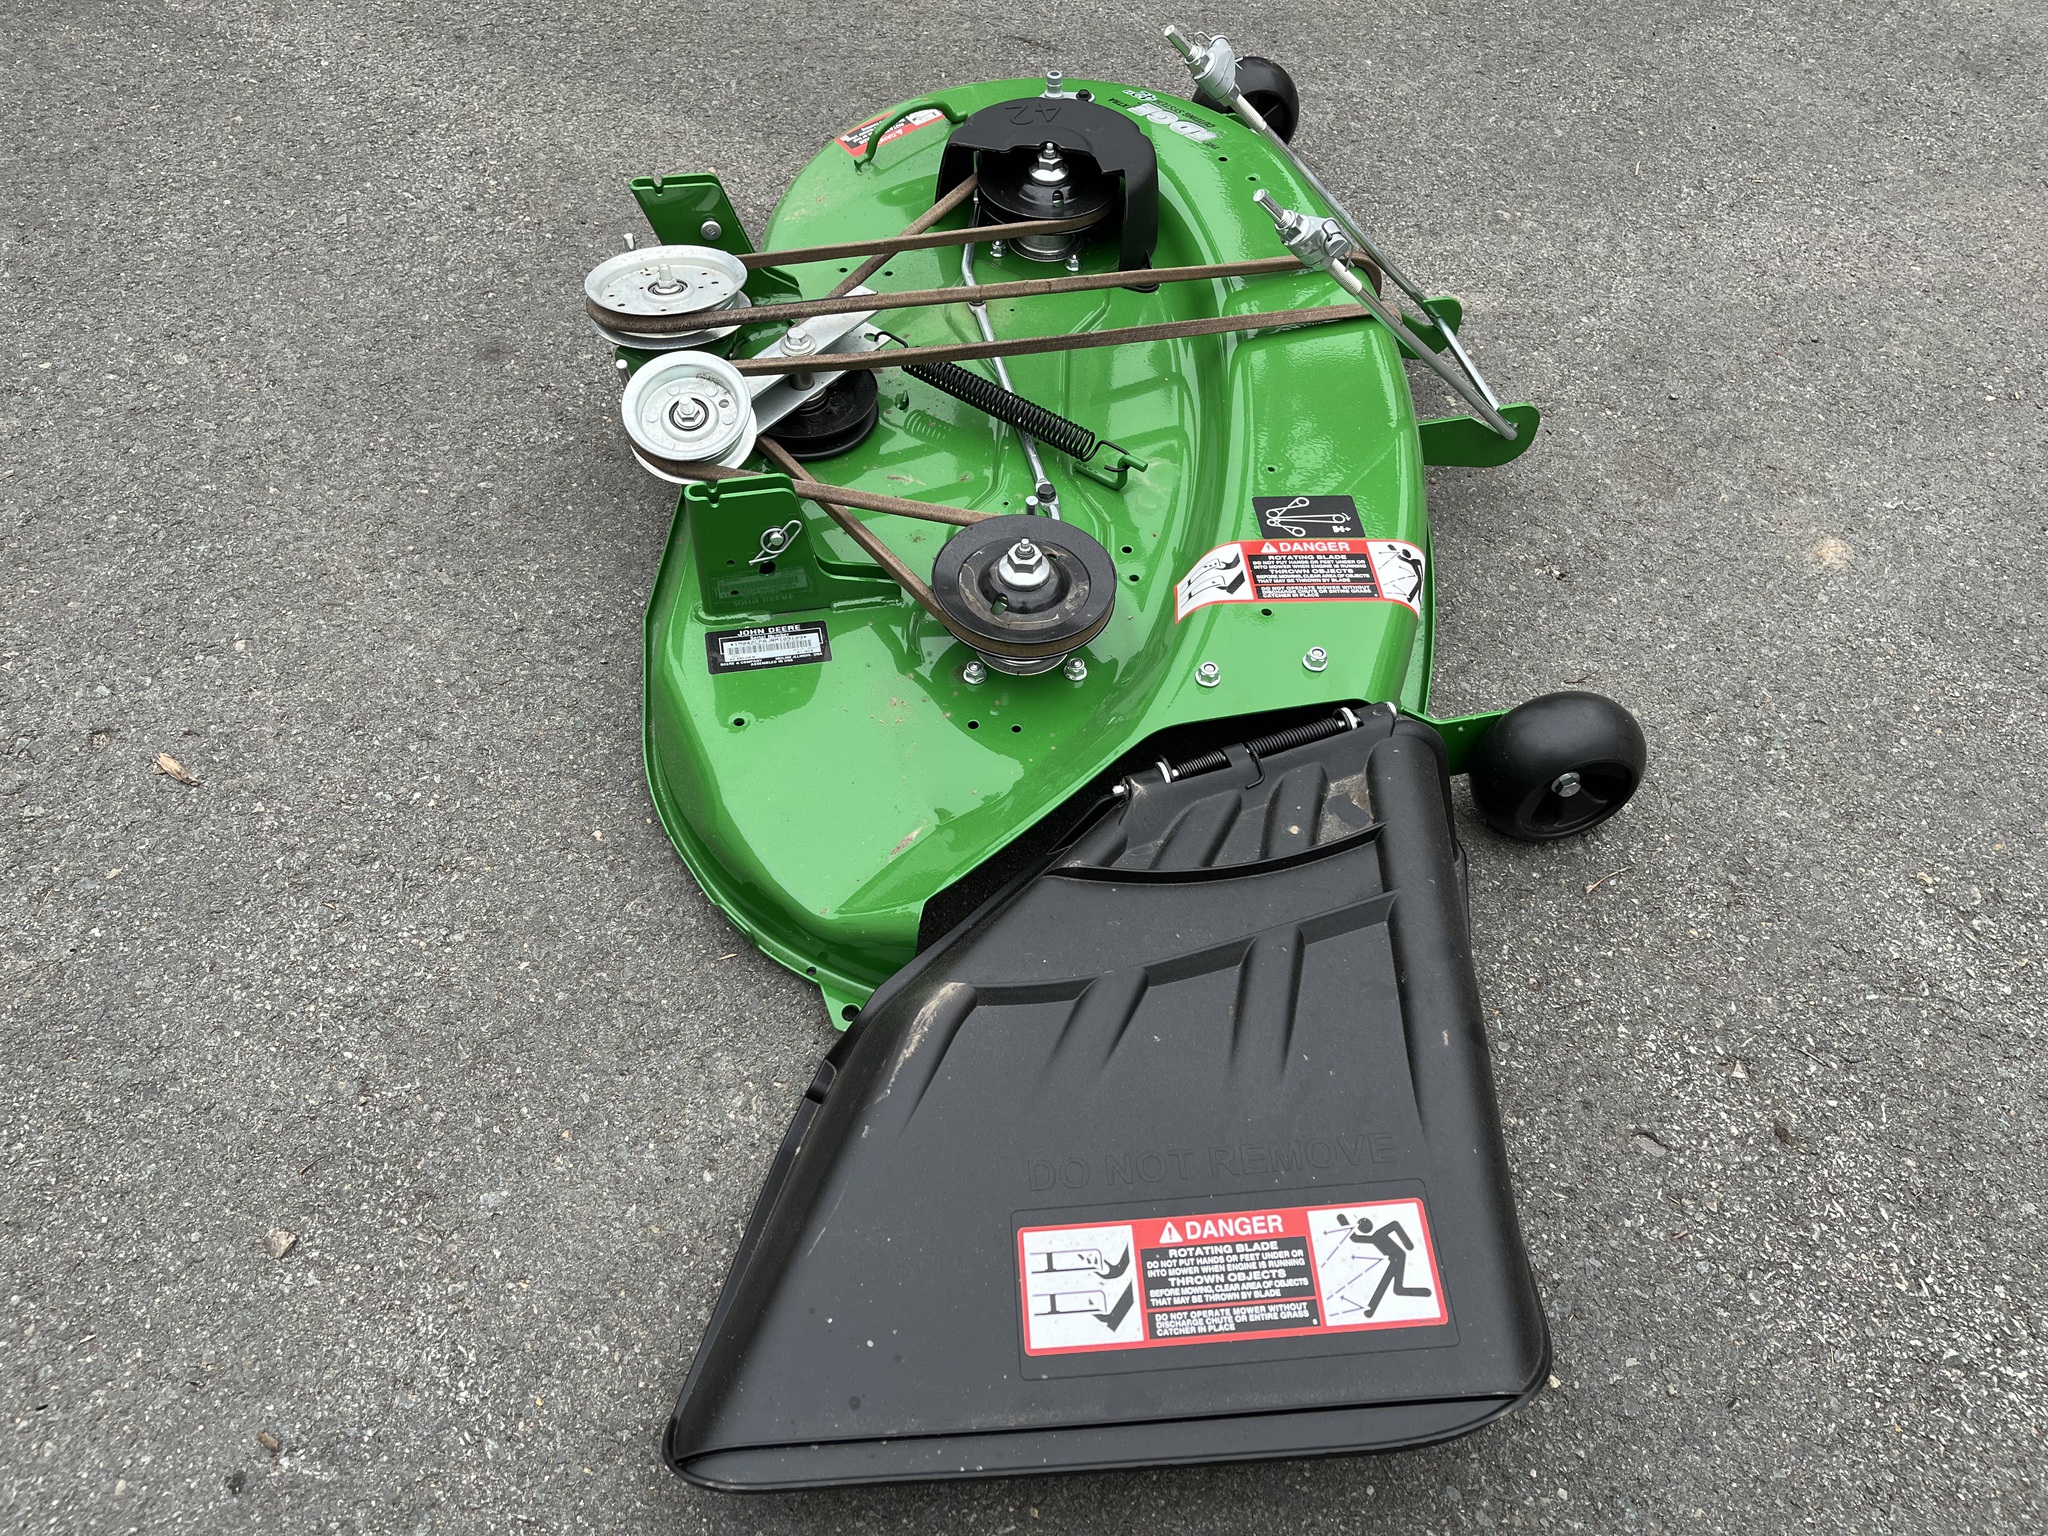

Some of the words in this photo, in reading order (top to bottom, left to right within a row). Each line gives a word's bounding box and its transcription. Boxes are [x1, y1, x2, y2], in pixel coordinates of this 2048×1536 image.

[1005, 102, 1062, 126] 42
[1152, 99, 1184, 114] SYSTEM
[1126, 102, 1218, 143] EDGE
[1182, 111, 1216, 128] CUTTING
[1279, 542, 1350, 552] DANGER
[737, 628, 765, 637] JOHN
[768, 624, 801, 634] DEERE
[1028, 1157, 1090, 1192] DO
[1105, 1148, 1194, 1186] NOT
[1208, 1131, 1398, 1178] REMOVE
[1185, 1214, 1284, 1240] DANGER
[1147, 1260, 1159, 1269] DO
[1160, 1259, 1177, 1268] NOT
[1178, 1258, 1195, 1267] PUT
[1197, 1256, 1224, 1265] HANDS
[1225, 1255, 1238, 1263] OR
[1240, 1253, 1260, 1262] FEET
[1262, 1251, 1289, 1260] UNDER
[1291, 1249, 1304, 1258] OR
[1168, 1244, 1233, 1258] ROTATING
[1236, 1241, 1278, 1253] BLADE
[1148, 1268, 1167, 1278] INTO
[1168, 1266, 1199, 1277] MOWER
[1201, 1265, 1225, 1274] WHEN
[1226, 1262, 1257, 1272] ENGINE
[1258, 1260, 1267, 1269] IS
[1268, 1258, 1305, 1268] RUNNING
[1168, 1272, 1225, 1287] THROWN
[1228, 1269, 1286, 1282] OBJECTS
[1150, 1288, 1180, 1298] BEFORE
[1215, 1284, 1240, 1293] CLEAR
[1241, 1282, 1262, 1291] AREA
[1262, 1281, 1273, 1290] OF
[1274, 1278, 1309, 1288] OBJECTS
[1150, 1297, 1172, 1307] THAT
[1174, 1296, 1191, 1305] MAY
[1192, 1294, 1203, 1303] BE
[1204, 1292, 1240, 1302] THROWN
[1241, 1291, 1252, 1299] BY
[1253, 1288, 1281, 1298] BLADE
[1155, 1314, 1168, 1322] DO
[1170, 1312, 1188, 1321] NOT
[1190, 1308, 1231, 1319] OPERATE
[1233, 1306, 1266, 1316] MOWER
[1268, 1302, 1308, 1312] WITHOUT
[1156, 1318, 1204, 1329] DISCHARGE
[1206, 1316, 1233, 1325] CHUTE
[1235, 1314, 1247, 1323] OR
[1249, 1312, 1278, 1322] ENTIRE
[1280, 1310, 1309, 1319] GRASS
[1157, 1326, 1196, 1336] CATCHER
[1208, 1323, 1235, 1332] PLACE
